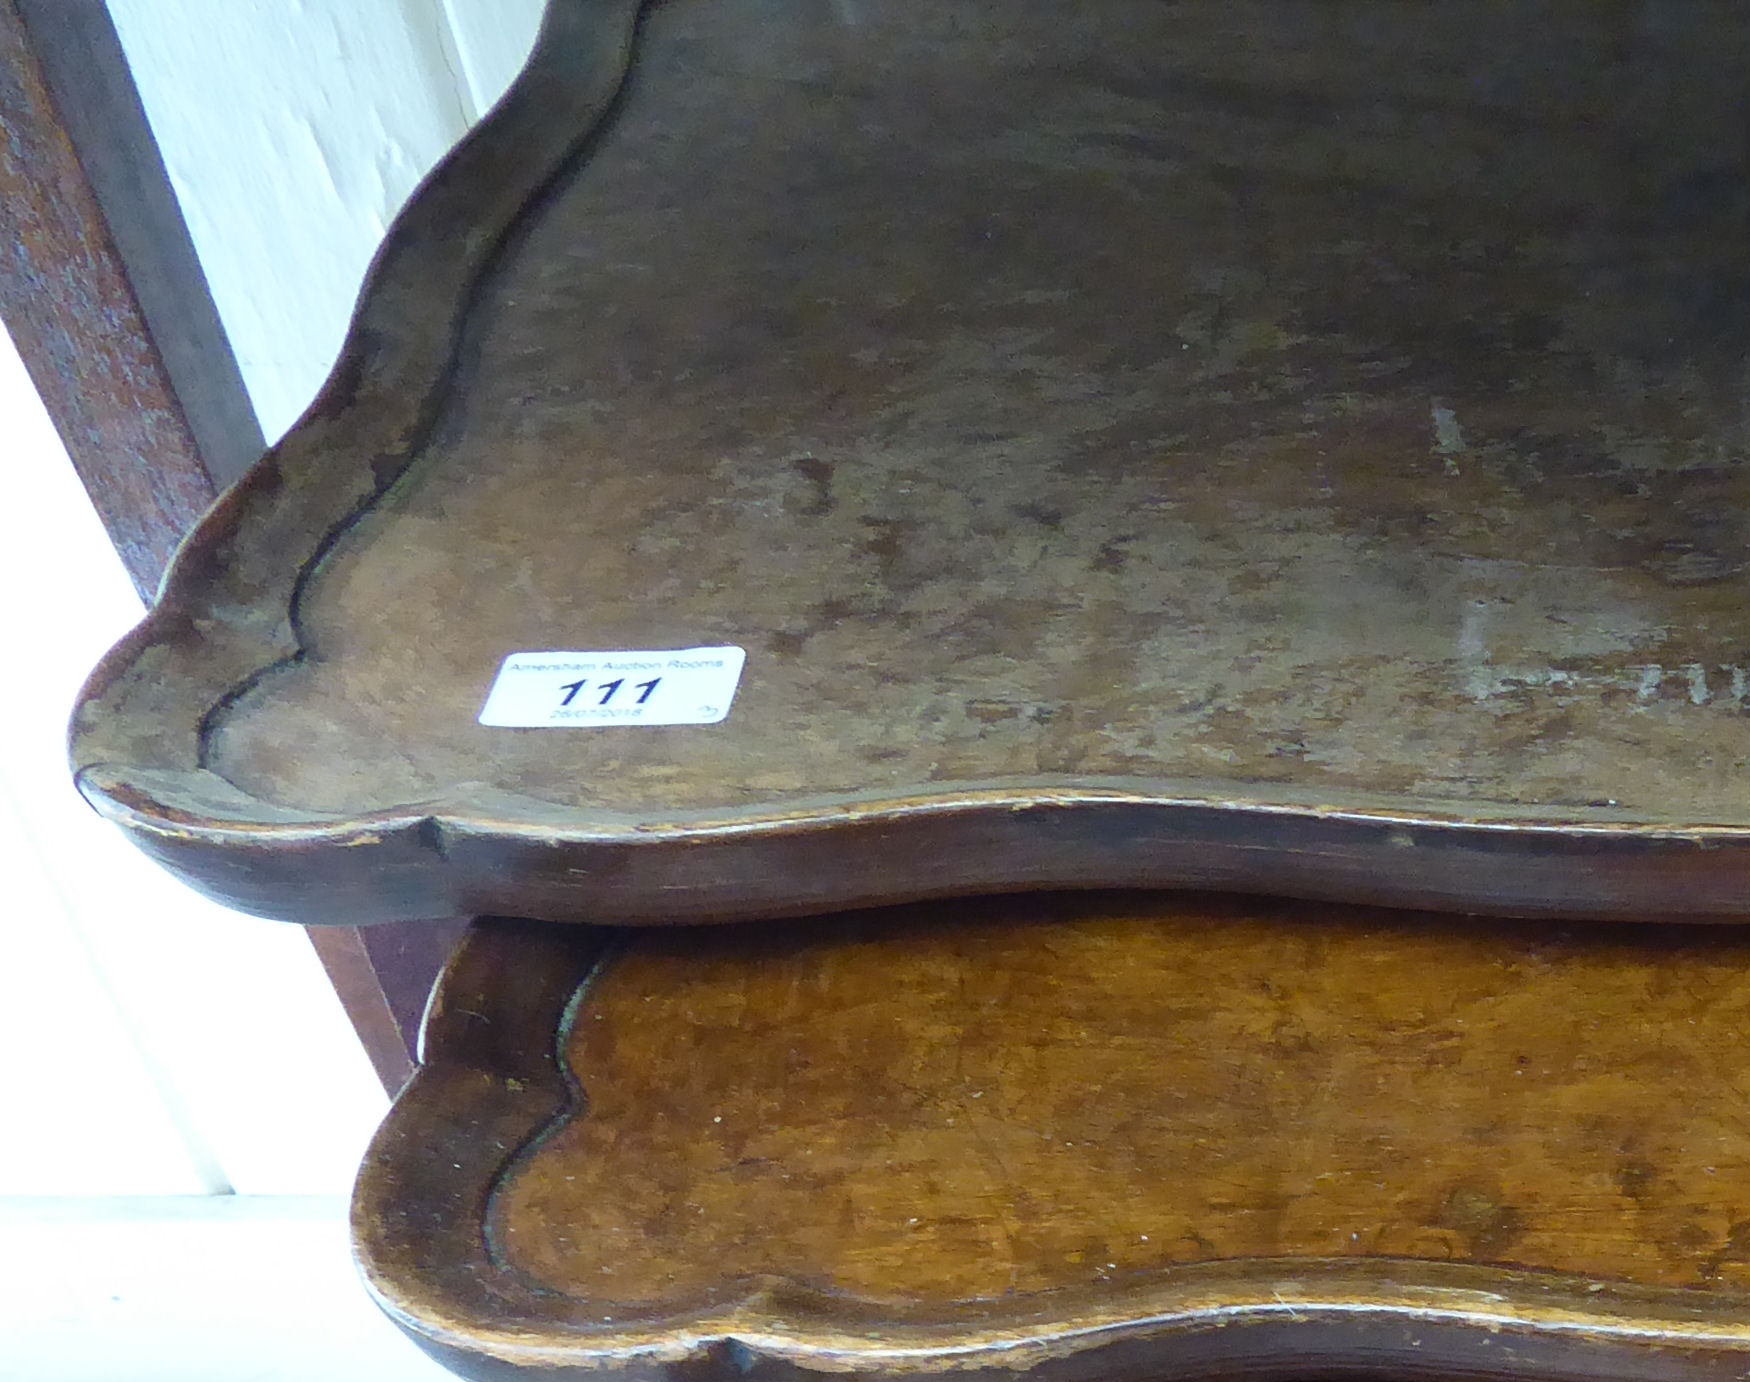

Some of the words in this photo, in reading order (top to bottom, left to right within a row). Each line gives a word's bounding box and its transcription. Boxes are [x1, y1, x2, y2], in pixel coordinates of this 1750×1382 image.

[509, 662, 597, 673] Amersham
[602, 661, 663, 671] Auction
[666, 658, 725, 669] Rooms
[559, 676, 663, 706] 111
